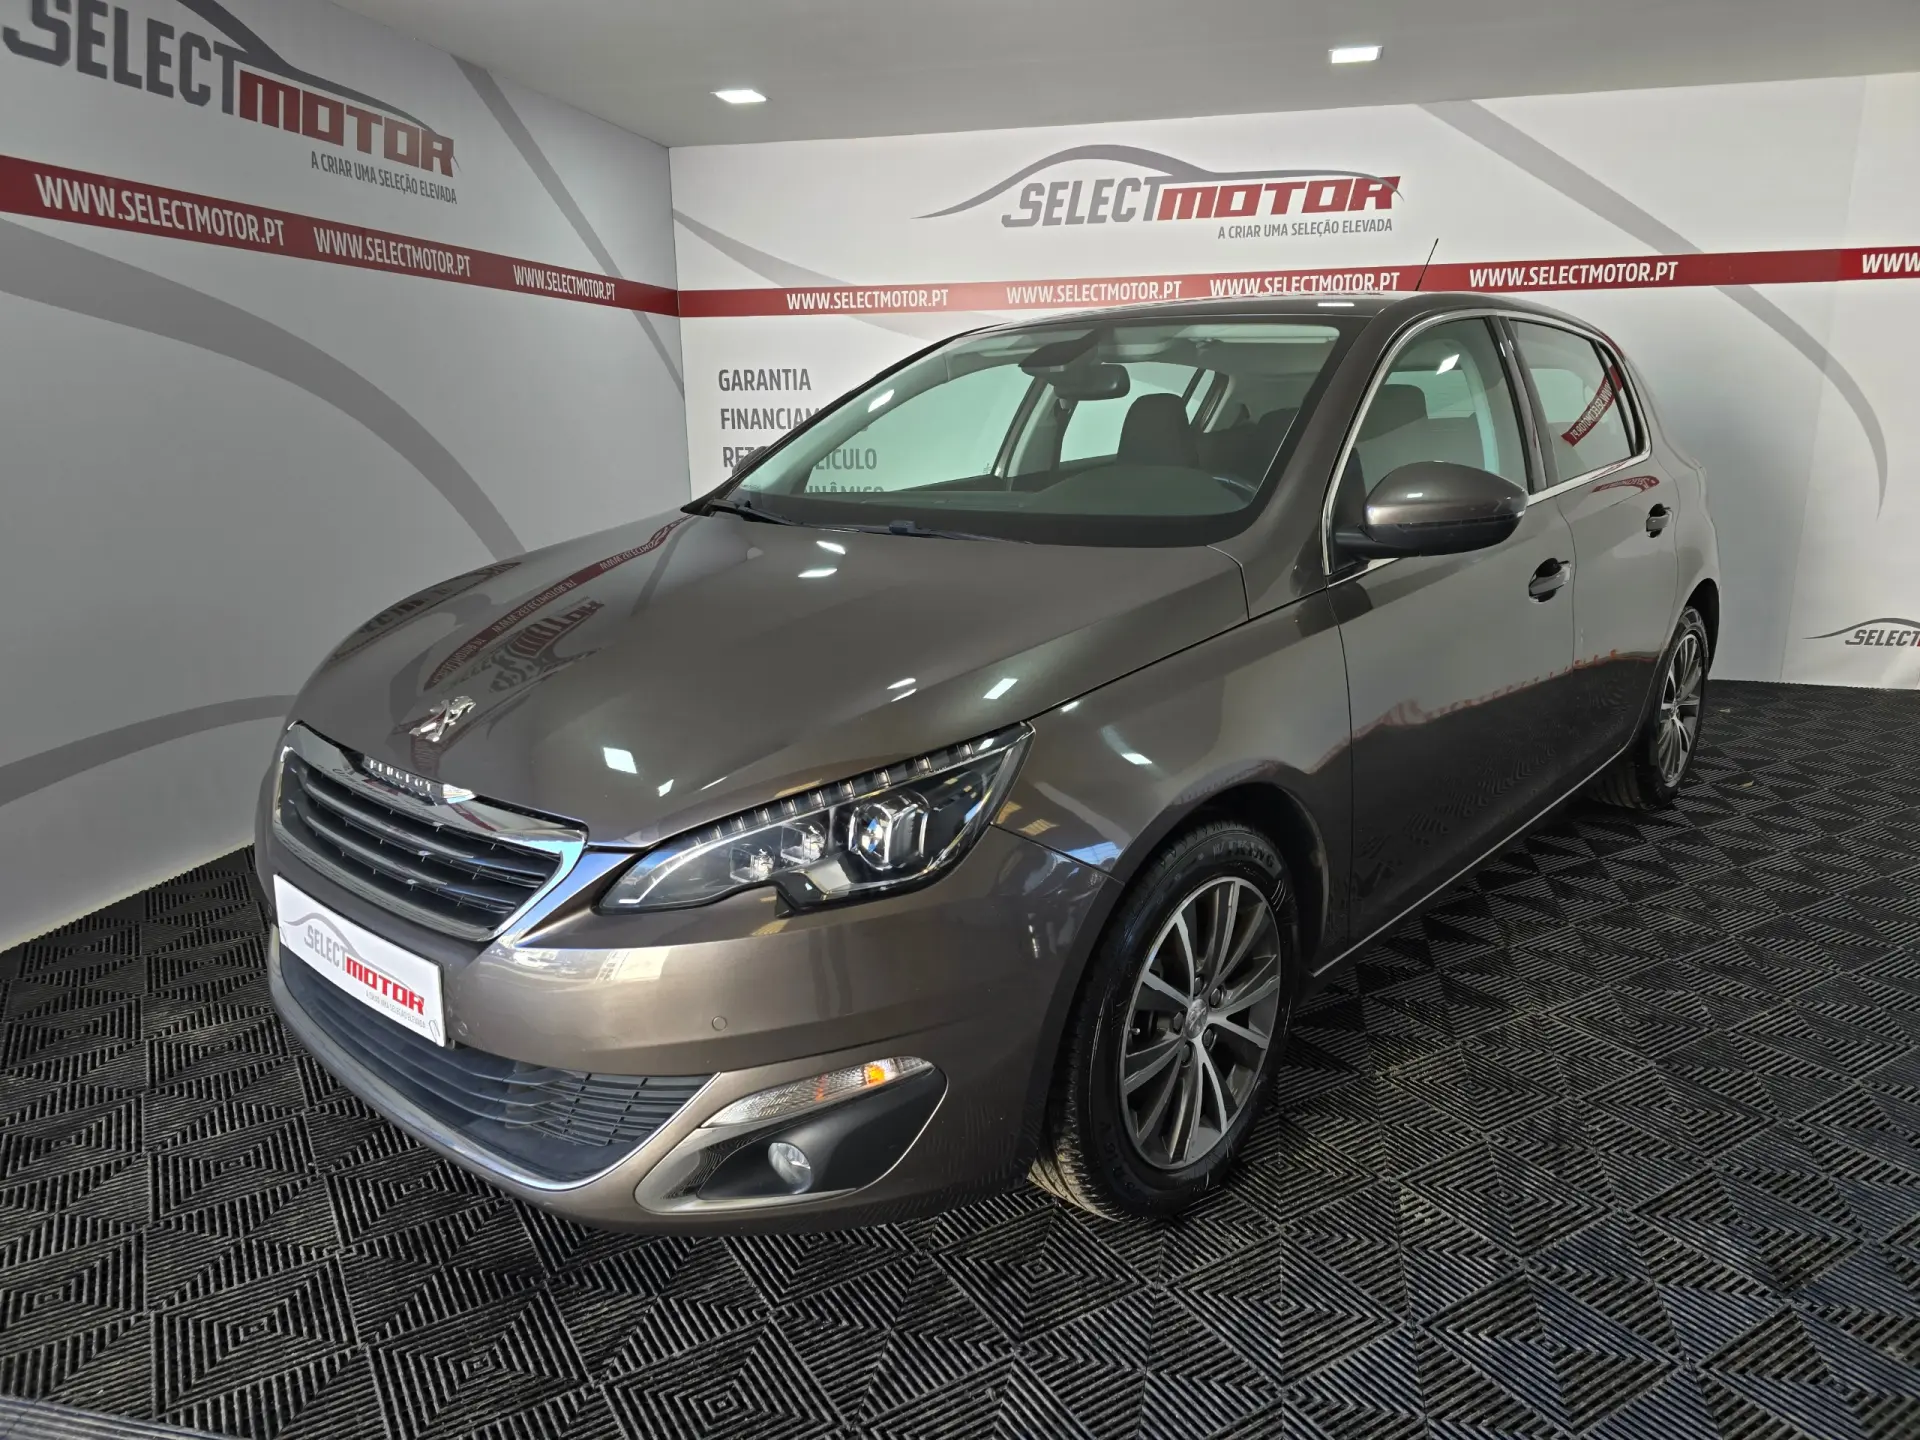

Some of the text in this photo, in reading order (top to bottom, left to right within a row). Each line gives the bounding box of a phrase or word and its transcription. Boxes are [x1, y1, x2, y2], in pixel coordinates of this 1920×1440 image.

[311, 151, 458, 205] A CRIAR UMA SELEÇÃO ELEVADA
[34, 173, 284, 246] WWW.SELECTMOTOR.PT
[1218, 218, 1393, 239] A CRIAR UMA SELEÇÃO ELEVADA
[313, 226, 470, 277] WWW.SELECTMOTOR.PT
[513, 264, 616, 301] WWW.SELECTMOTOR.PT
[1210, 272, 1400, 297] WWW.SELECTMOTOR.PT
[1470, 261, 1679, 288] WWW.SELECTMOTOR.PT
[787, 289, 949, 310] WWW.SELECTMOTOR.PT
[1007, 280, 1182, 304] WWW.SELECTMOTOR.PT
[718, 368, 812, 391] GARANTIA
[1844, 629, 1920, 647] SELECT
